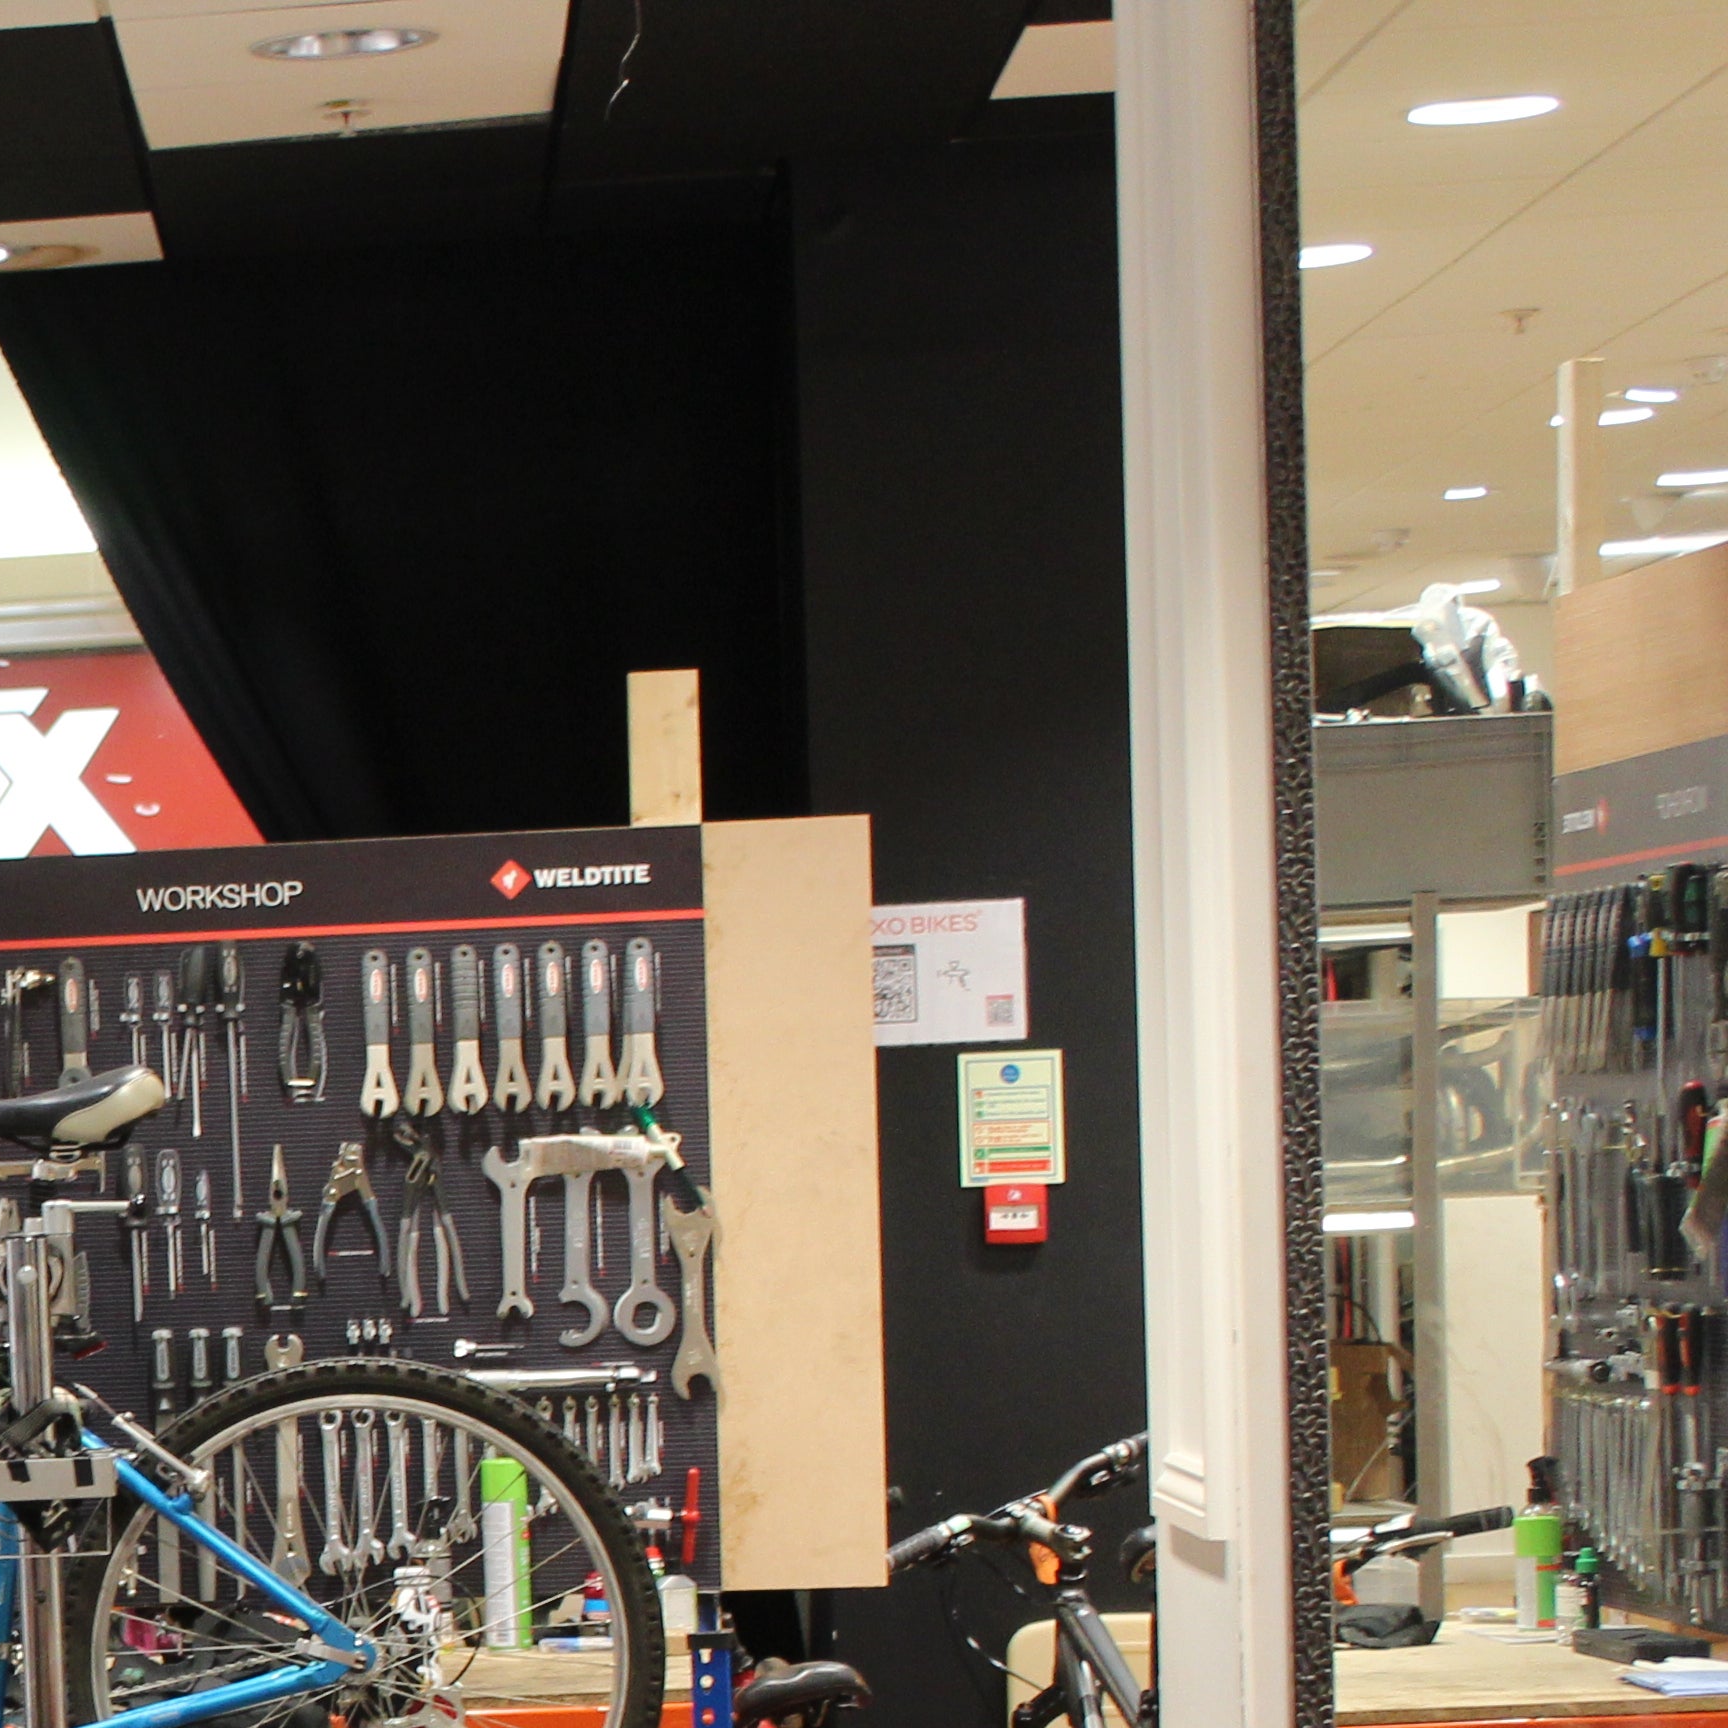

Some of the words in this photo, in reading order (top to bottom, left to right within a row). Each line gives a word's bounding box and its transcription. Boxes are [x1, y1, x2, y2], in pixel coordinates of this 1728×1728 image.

[533, 863, 651, 889] WELDTITE
[136, 881, 303, 912] WORKSHOP
[910, 913, 979, 935] BIKES
